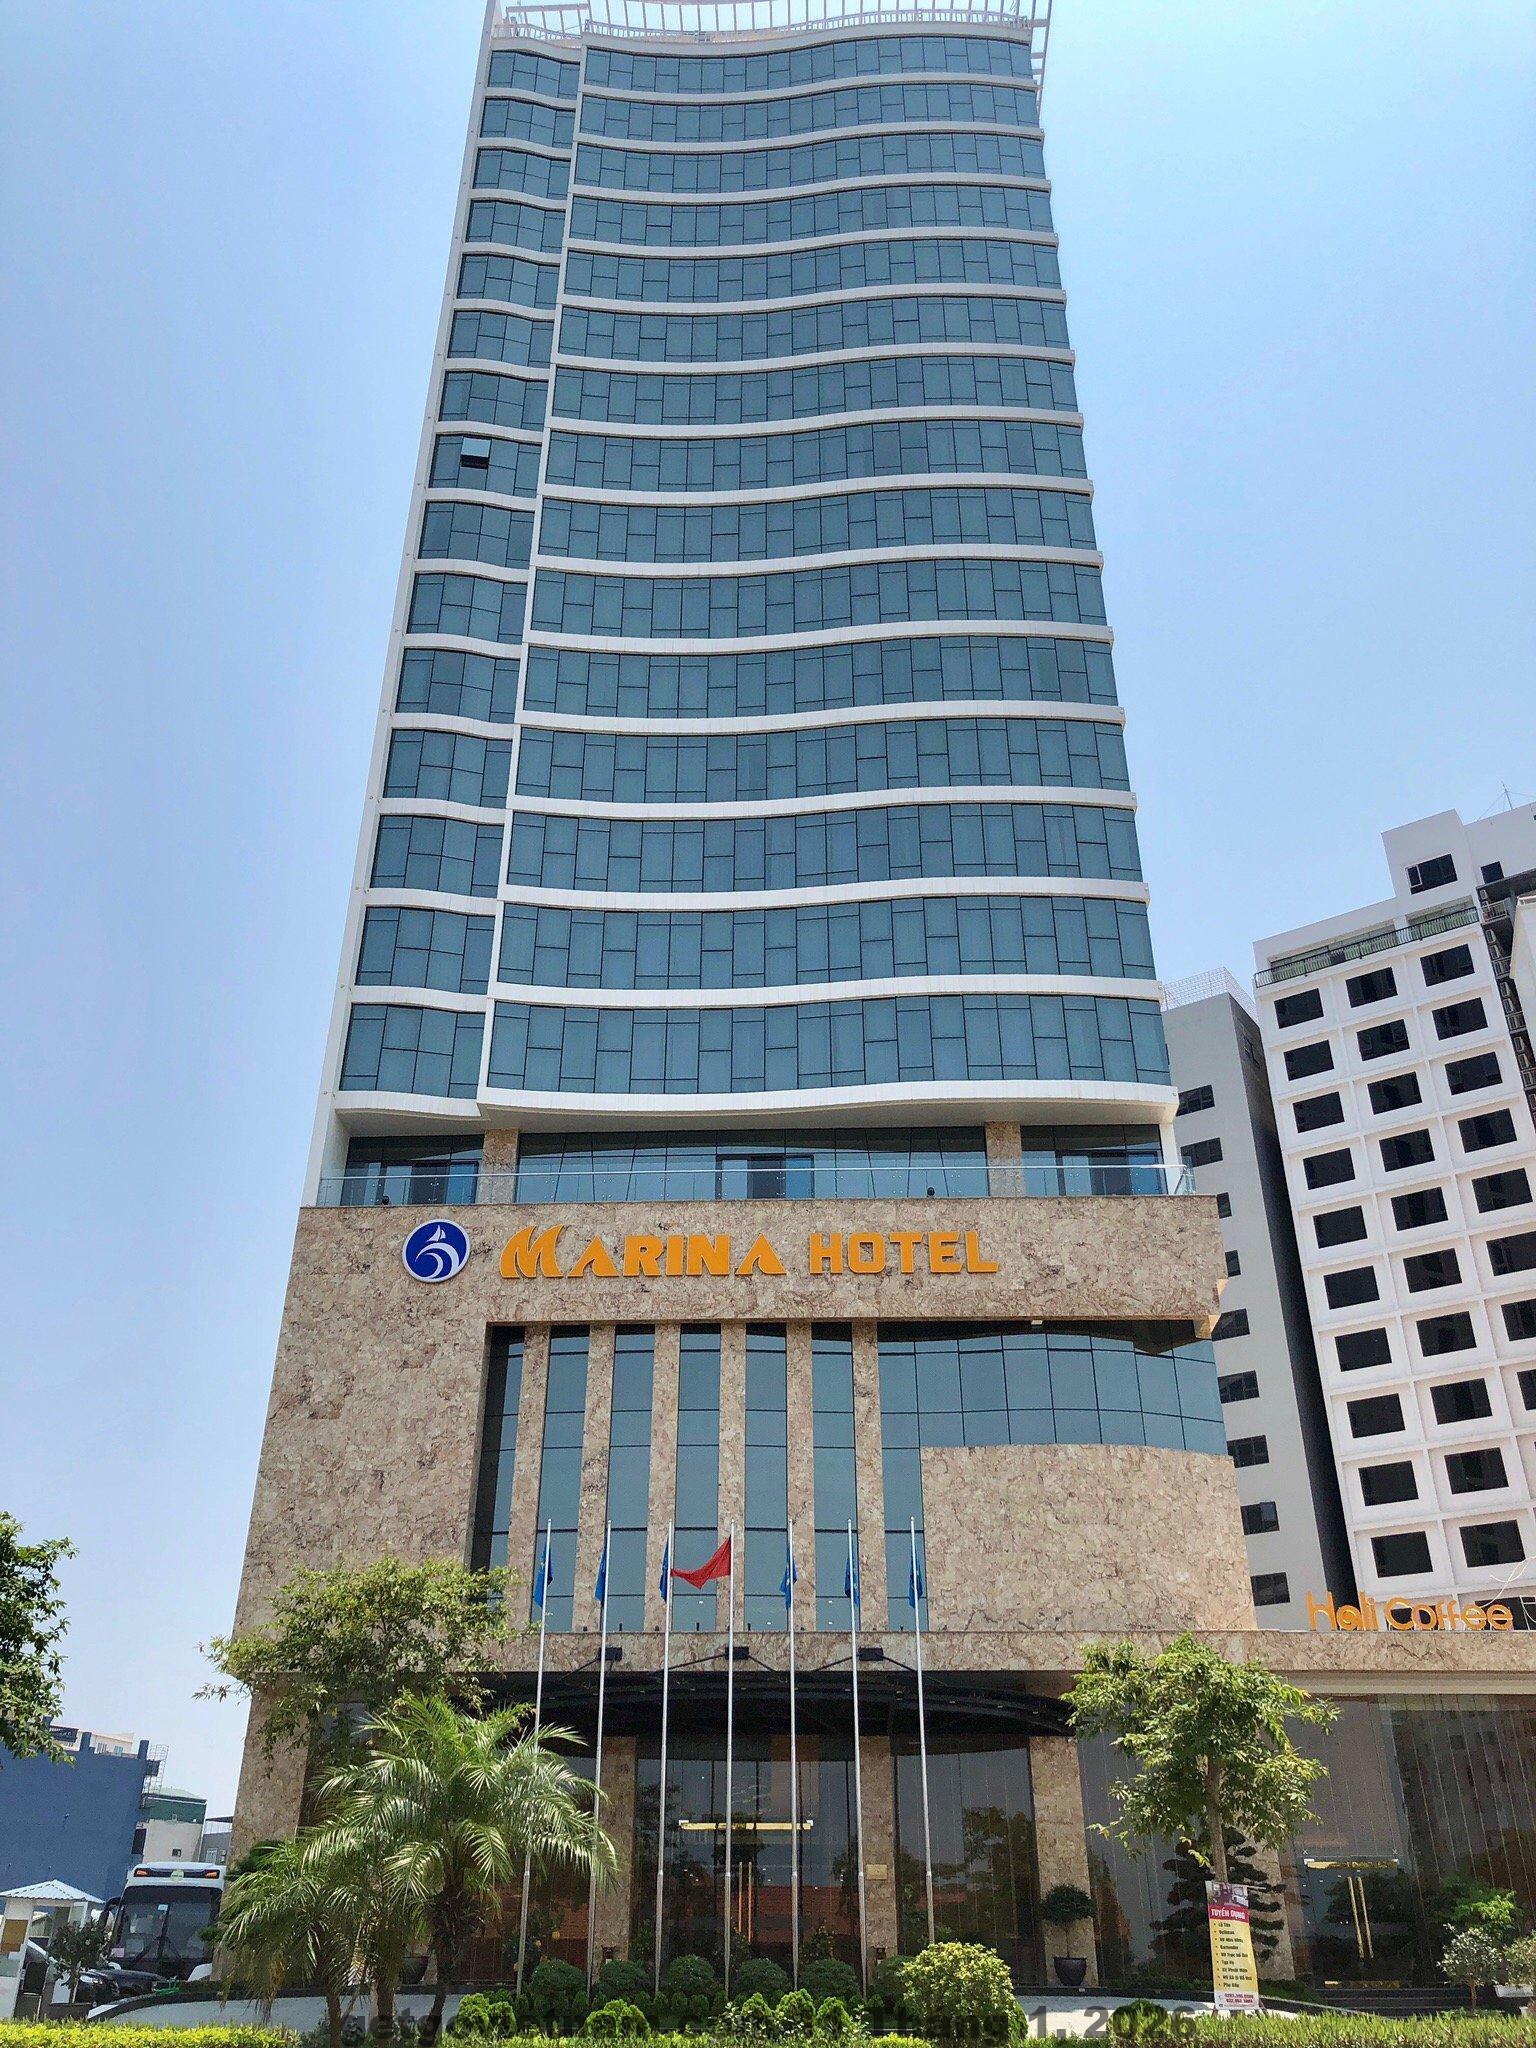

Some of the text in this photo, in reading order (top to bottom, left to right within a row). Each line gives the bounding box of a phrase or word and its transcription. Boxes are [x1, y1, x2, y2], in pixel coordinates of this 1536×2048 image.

[500, 1224, 999, 1279] MARINA HOTEL
[1385, 1597, 1513, 1631] Coffee
